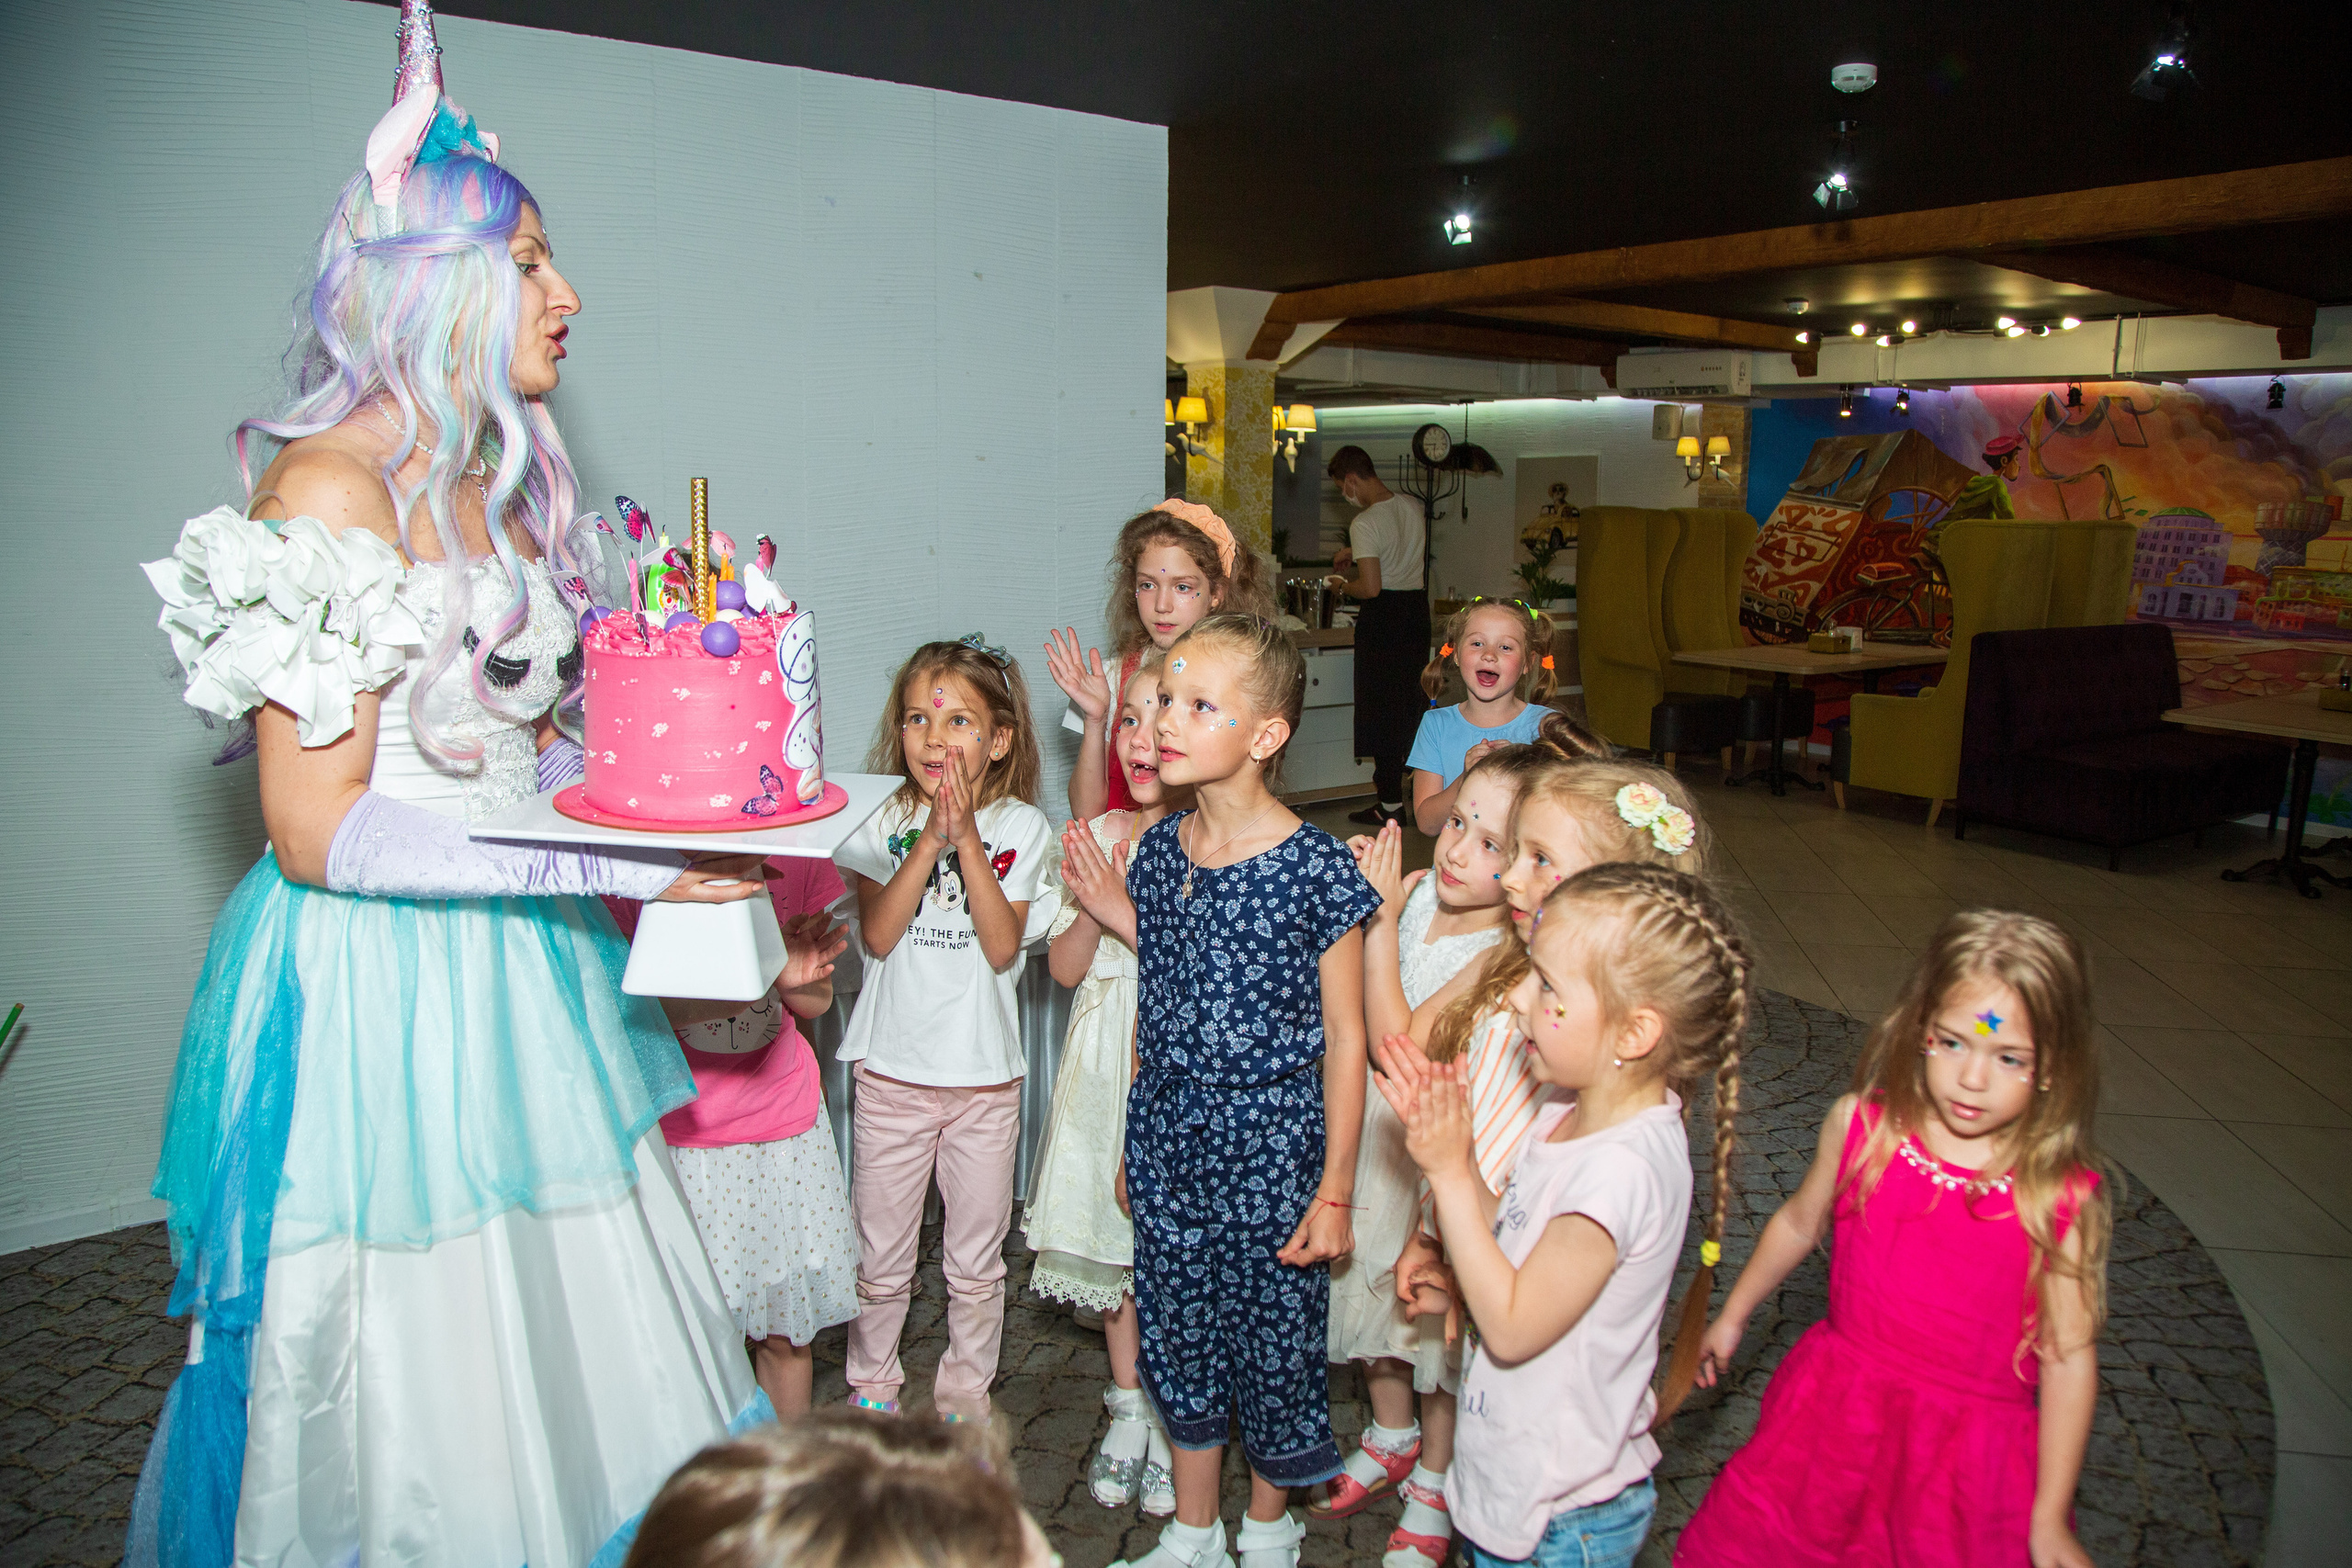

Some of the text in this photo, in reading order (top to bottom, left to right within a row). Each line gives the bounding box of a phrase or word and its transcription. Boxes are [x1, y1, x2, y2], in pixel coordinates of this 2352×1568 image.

[908, 925, 978, 940] EY! THE FUN
[913, 938, 969, 950] STARTS NOW
